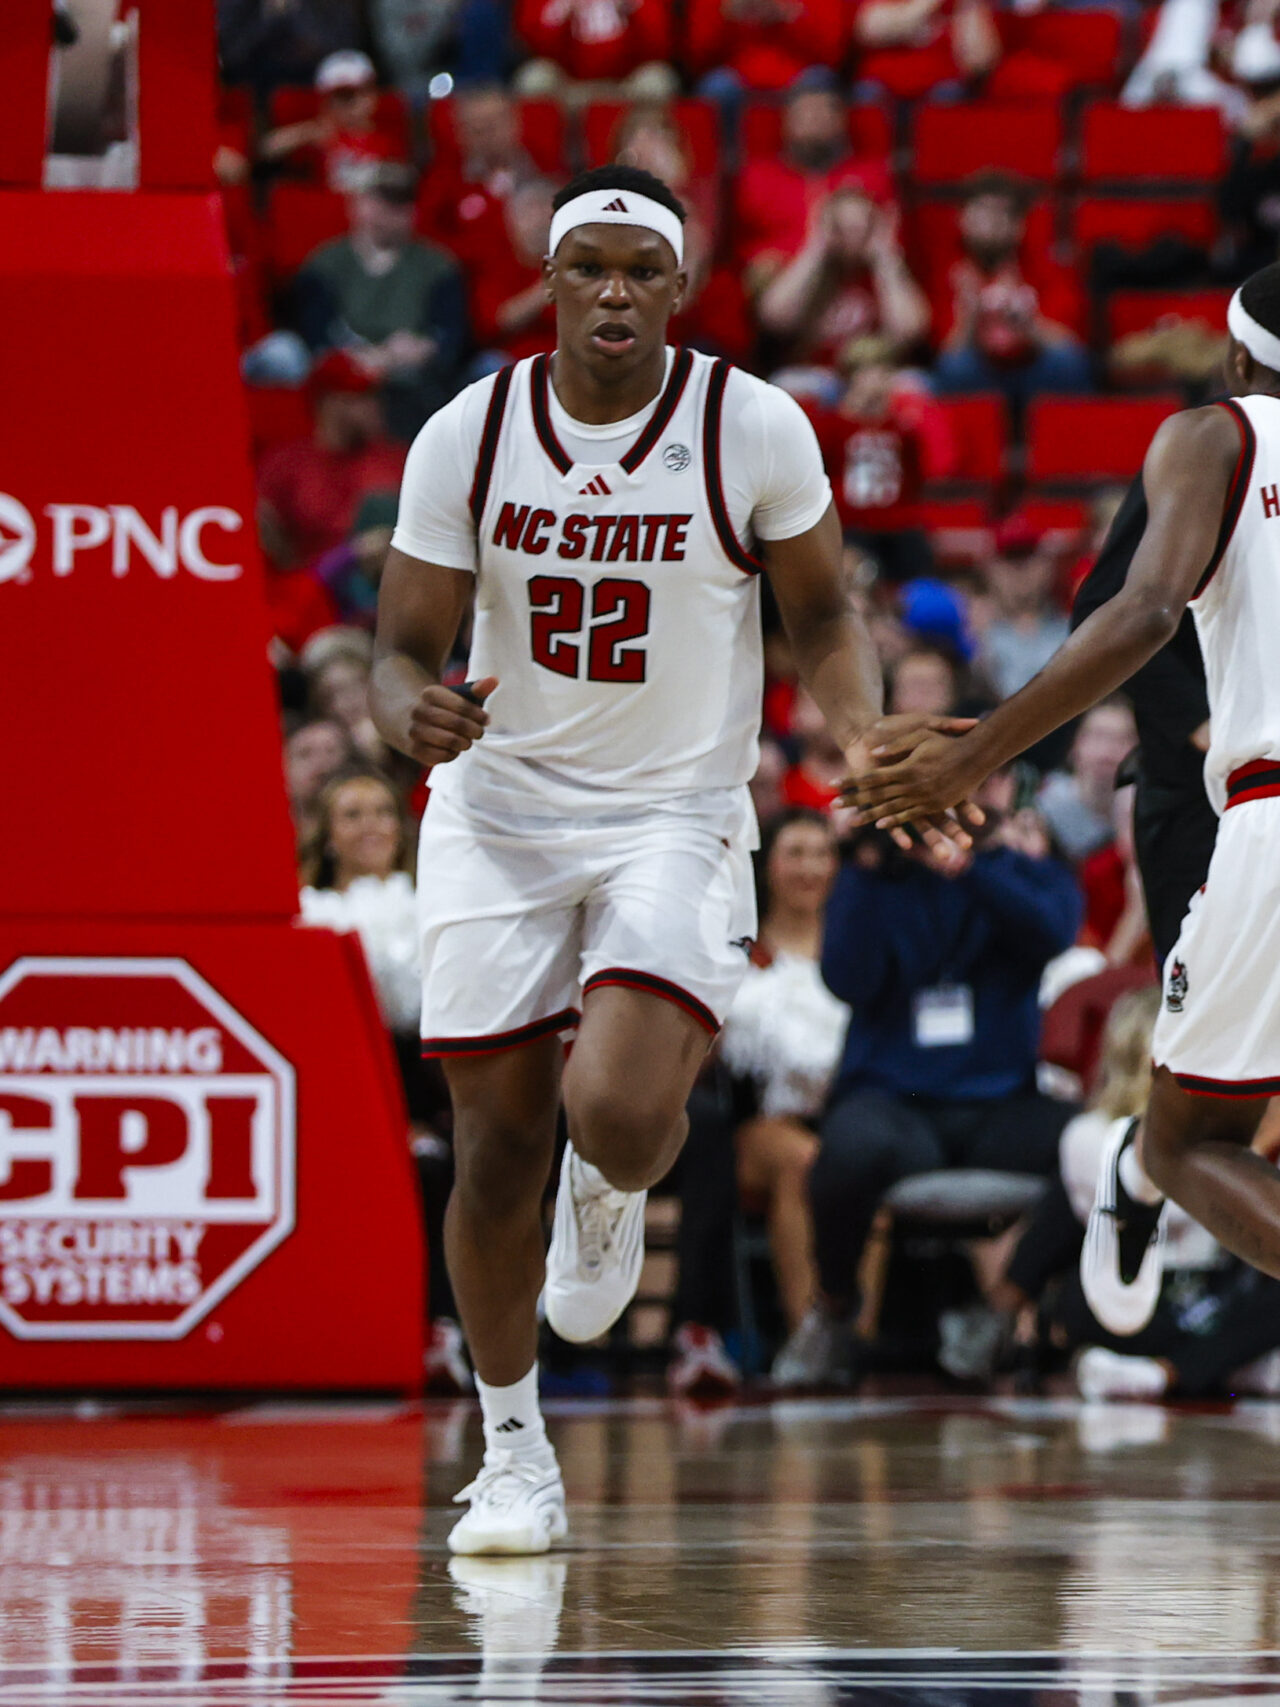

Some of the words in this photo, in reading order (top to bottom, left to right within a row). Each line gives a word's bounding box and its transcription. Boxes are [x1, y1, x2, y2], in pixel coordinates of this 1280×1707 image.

[43, 503, 243, 581] PNC
[492, 501, 557, 555] NC
[557, 513, 694, 562] STATE
[527, 575, 651, 683] 22
[0, 1027, 223, 1073] WARNING
[0, 1220, 206, 1261] SECURITY
[2, 1262, 202, 1305] SYSTEMS
